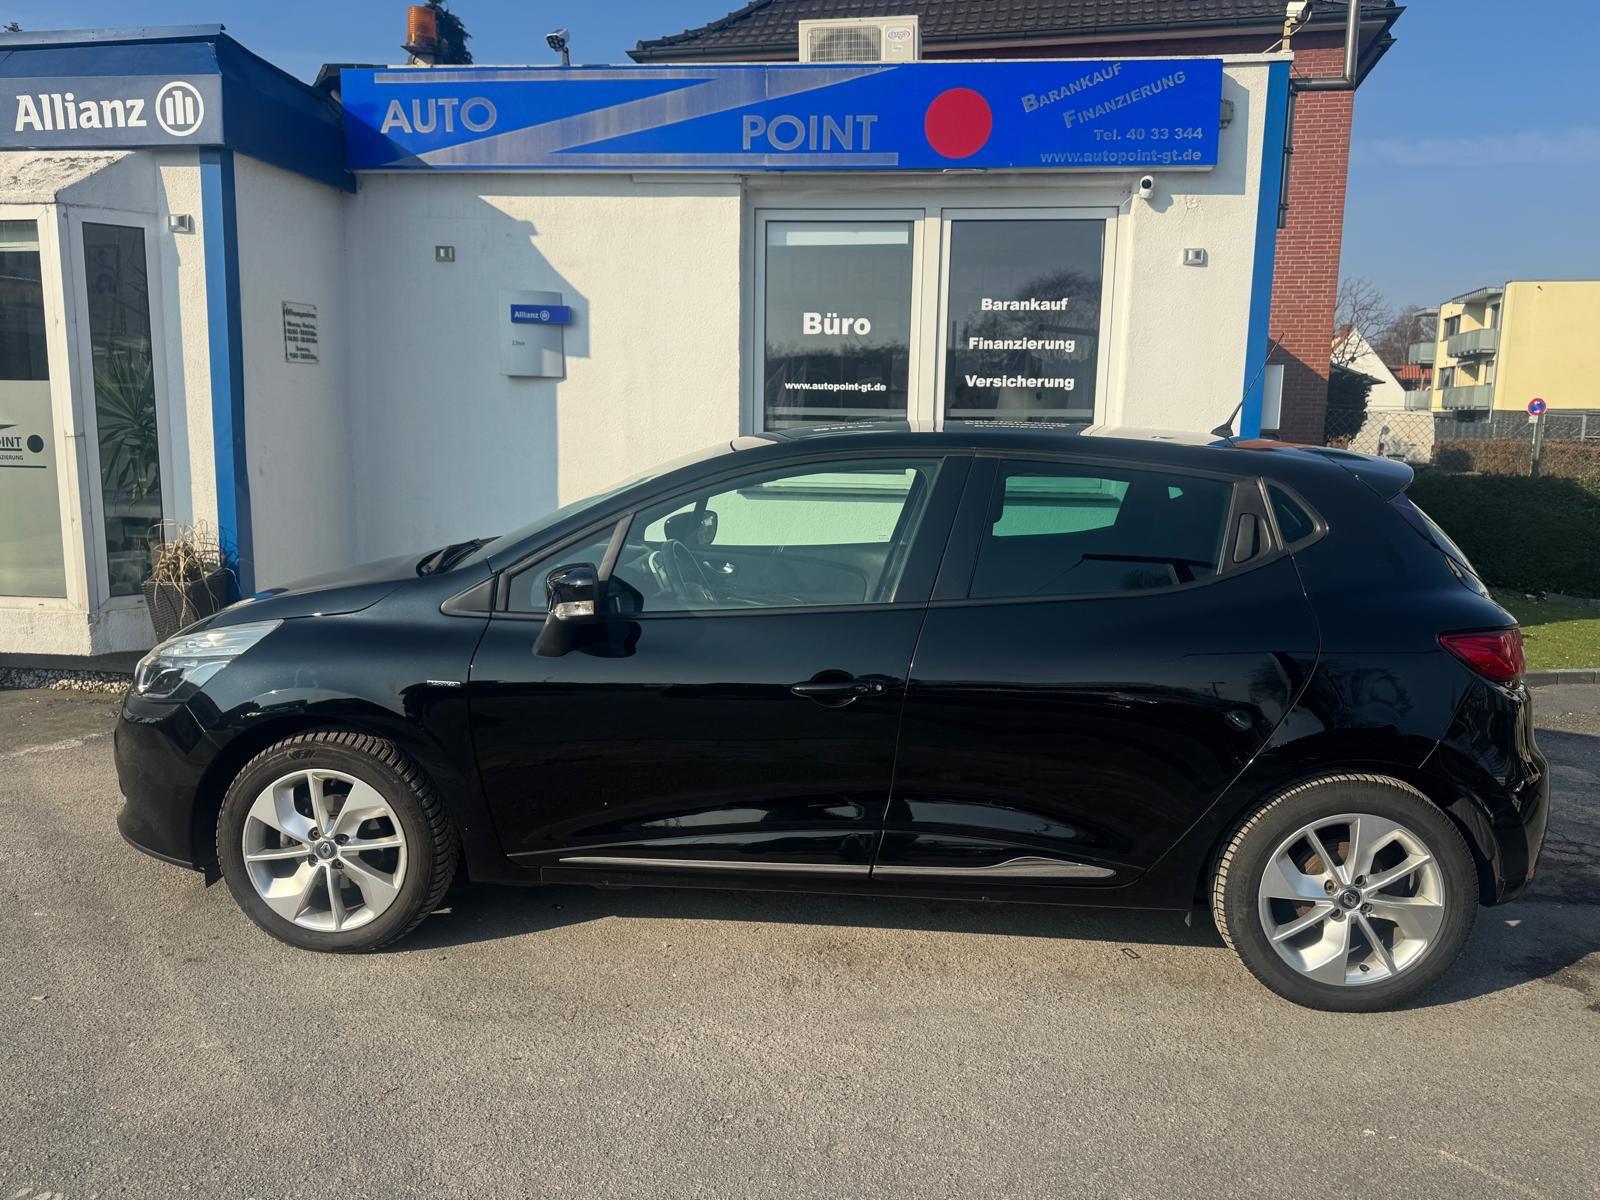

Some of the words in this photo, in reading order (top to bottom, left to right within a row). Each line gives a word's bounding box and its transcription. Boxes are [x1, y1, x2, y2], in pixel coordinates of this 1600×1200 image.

[1021, 62, 1123, 113] BARANKAUF
[1062, 71, 1187, 129] FINANZIERUNG
[14, 92, 147, 132] Allianz
[380, 96, 498, 134] AUTO
[742, 114, 878, 151] POINT
[1093, 128, 1121, 141] Tel.
[1126, 128, 1146, 140] 40
[1151, 128, 1169, 140] 33
[1174, 127, 1203, 139] 344
[1040, 148, 1203, 164] www.autopoint-gt.de
[981, 297, 1069, 311] Barankauf
[513, 311, 540, 319] Allianz
[802, 312, 872, 335] Büro
[968, 337, 1076, 353] Finanzierung
[784, 382, 887, 393] www.autopoint-gt.de
[964, 375, 1076, 391] Versicherung
[0, 436, 22, 448] INT
